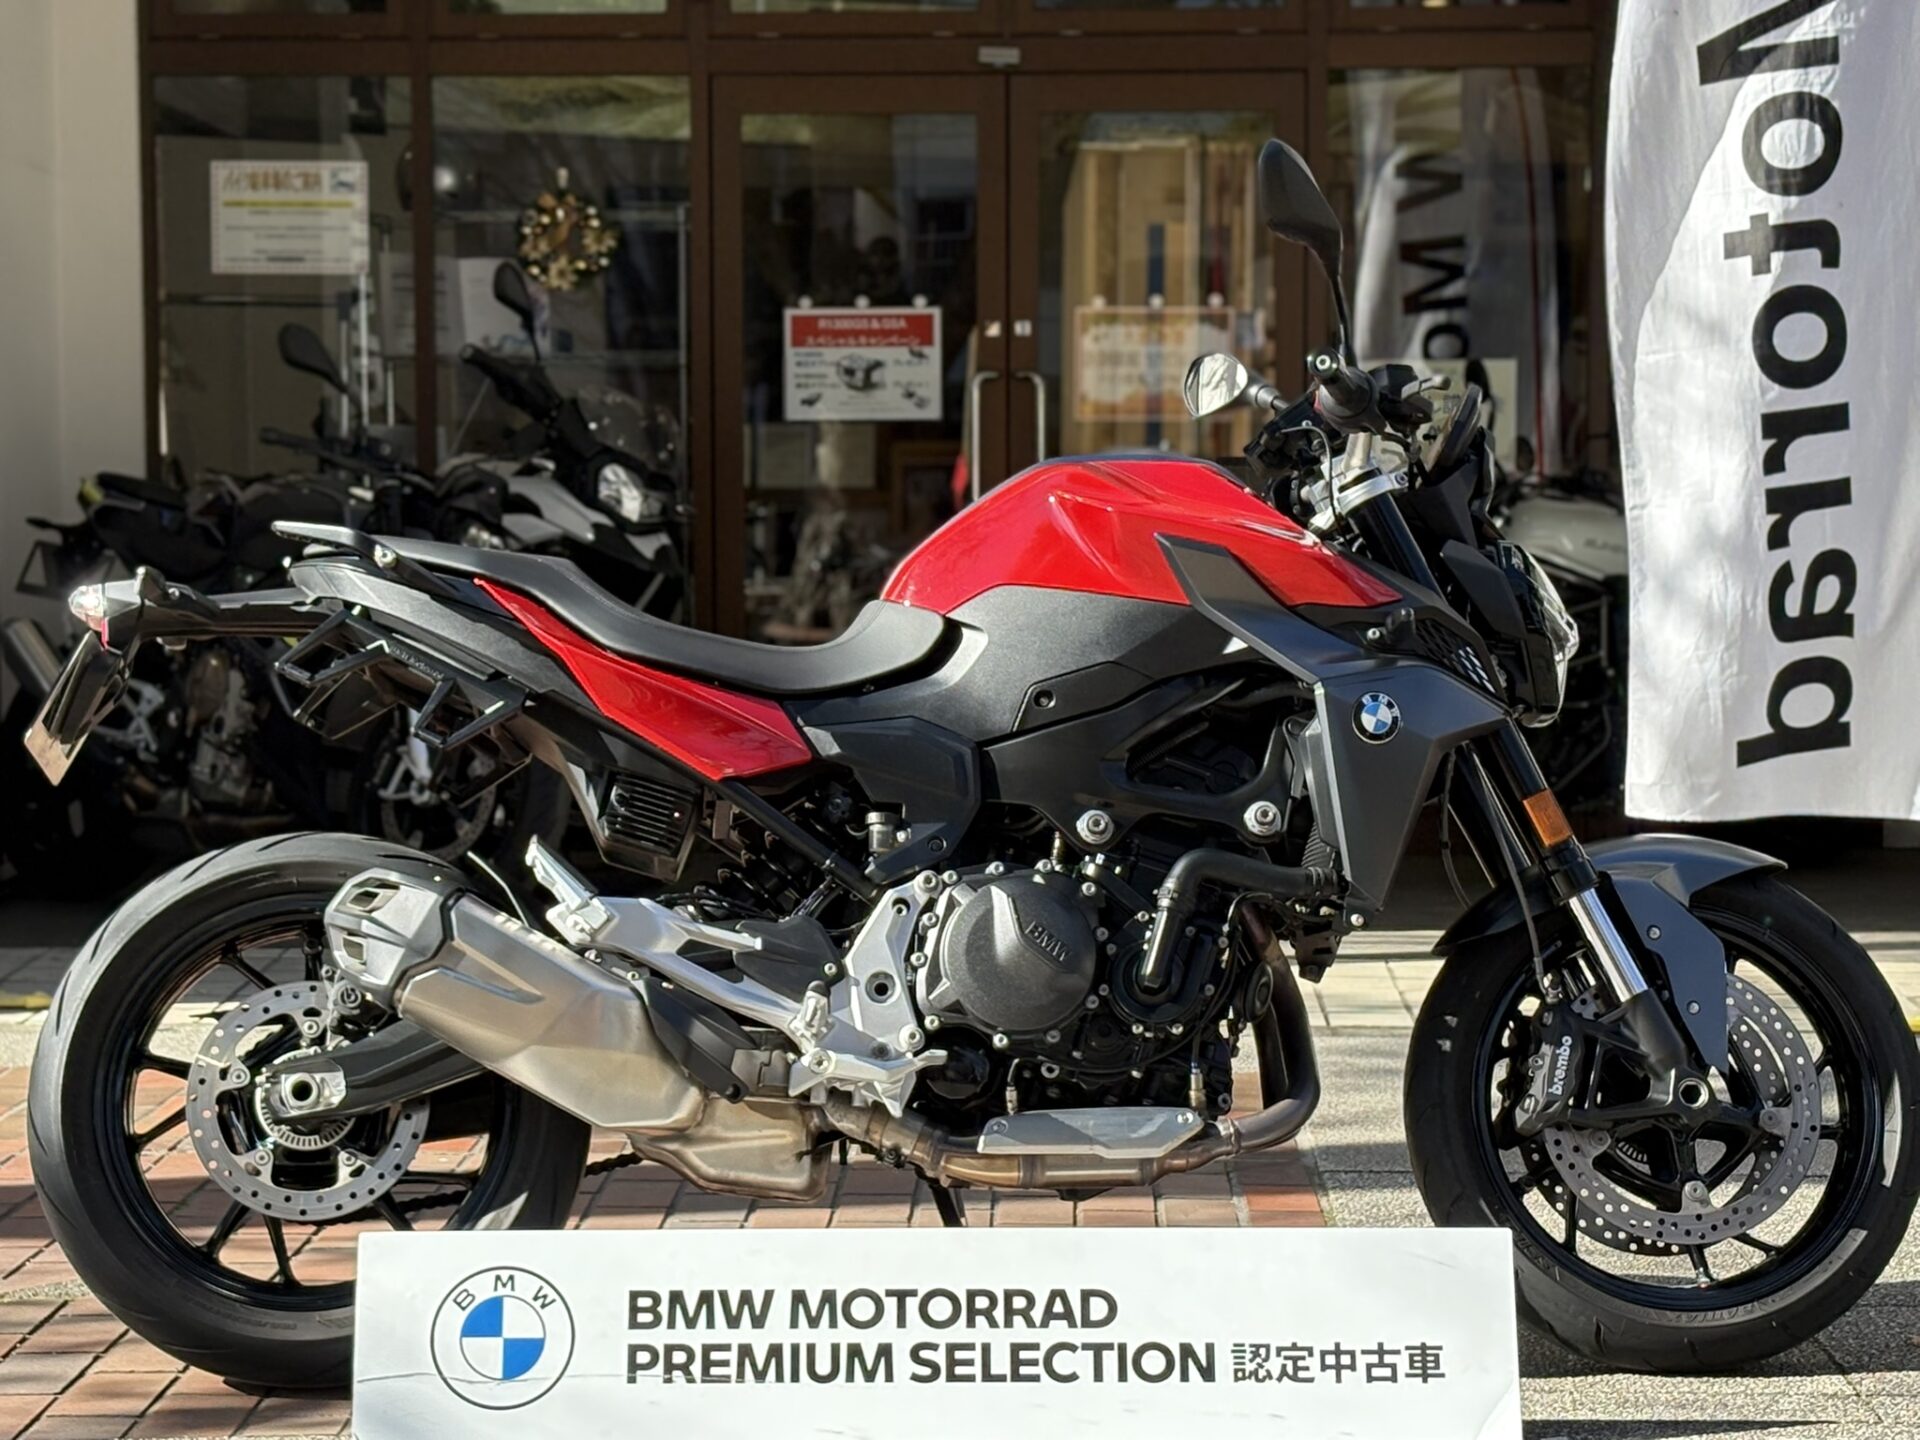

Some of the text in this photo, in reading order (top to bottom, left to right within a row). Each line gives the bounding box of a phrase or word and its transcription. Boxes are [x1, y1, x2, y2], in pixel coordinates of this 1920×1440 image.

[1024, 920, 1073, 961] BMW
[1548, 1035, 1573, 1095] brembo
[453, 1273, 557, 1312] BMW
[628, 1288, 1118, 1330] BMW MOTORRAD
[627, 1341, 1445, 1384] PREMIUM SELECTION 認定中古車
